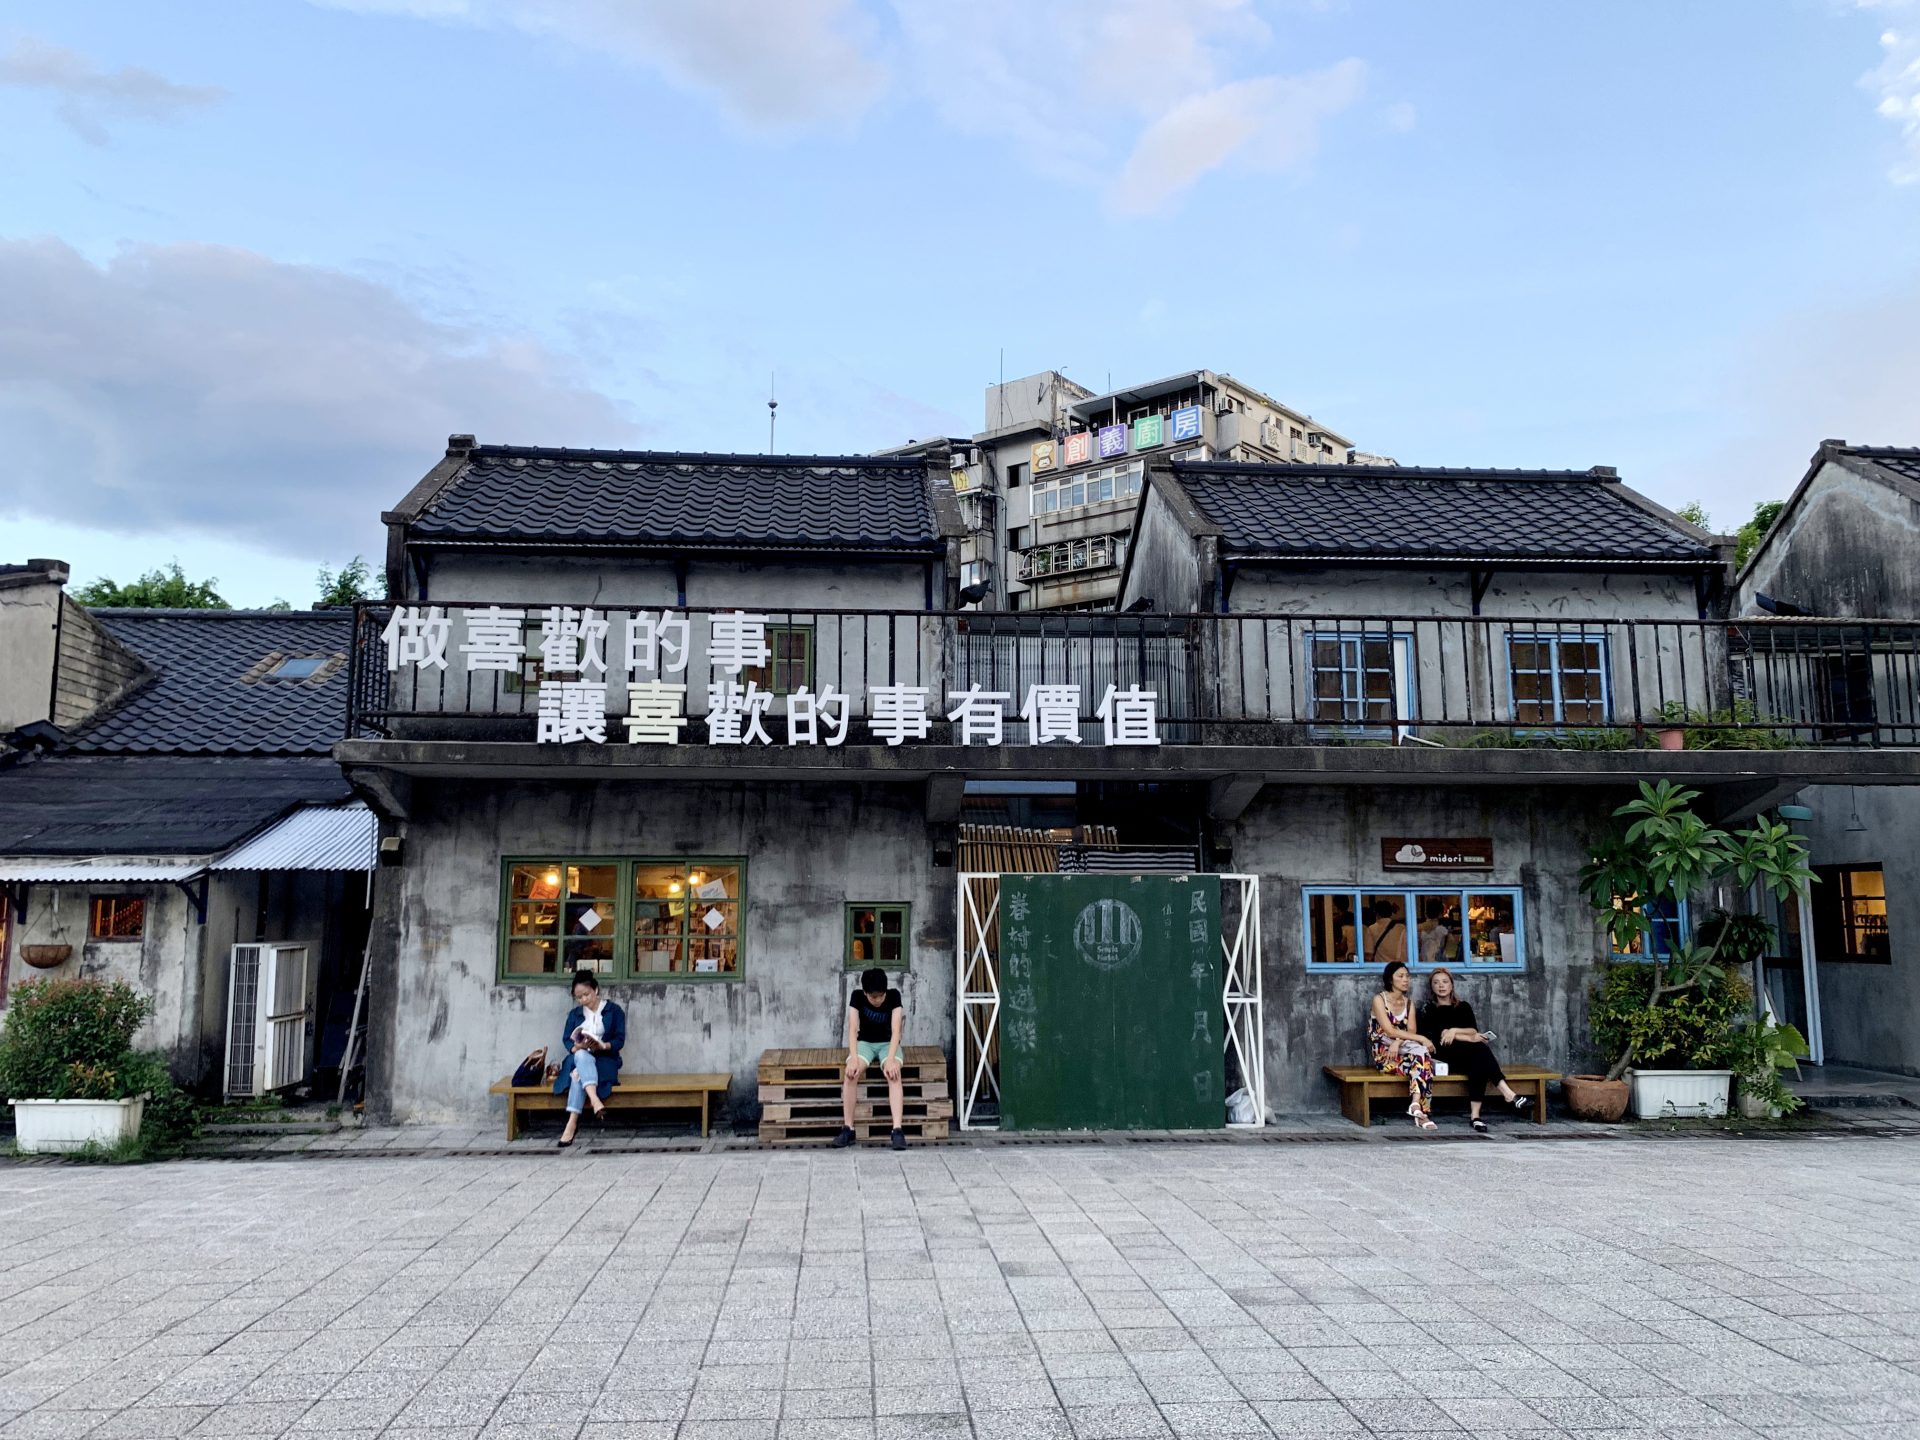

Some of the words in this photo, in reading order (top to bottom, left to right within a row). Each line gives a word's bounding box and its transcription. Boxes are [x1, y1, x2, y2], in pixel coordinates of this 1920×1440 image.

[1066, 409, 1198, 463] 創義廚房
[380, 605, 773, 676] 做喜歡的事
[537, 679, 1161, 748] 讓喜歡的事有價值
[1429, 853, 1462, 863] midori
